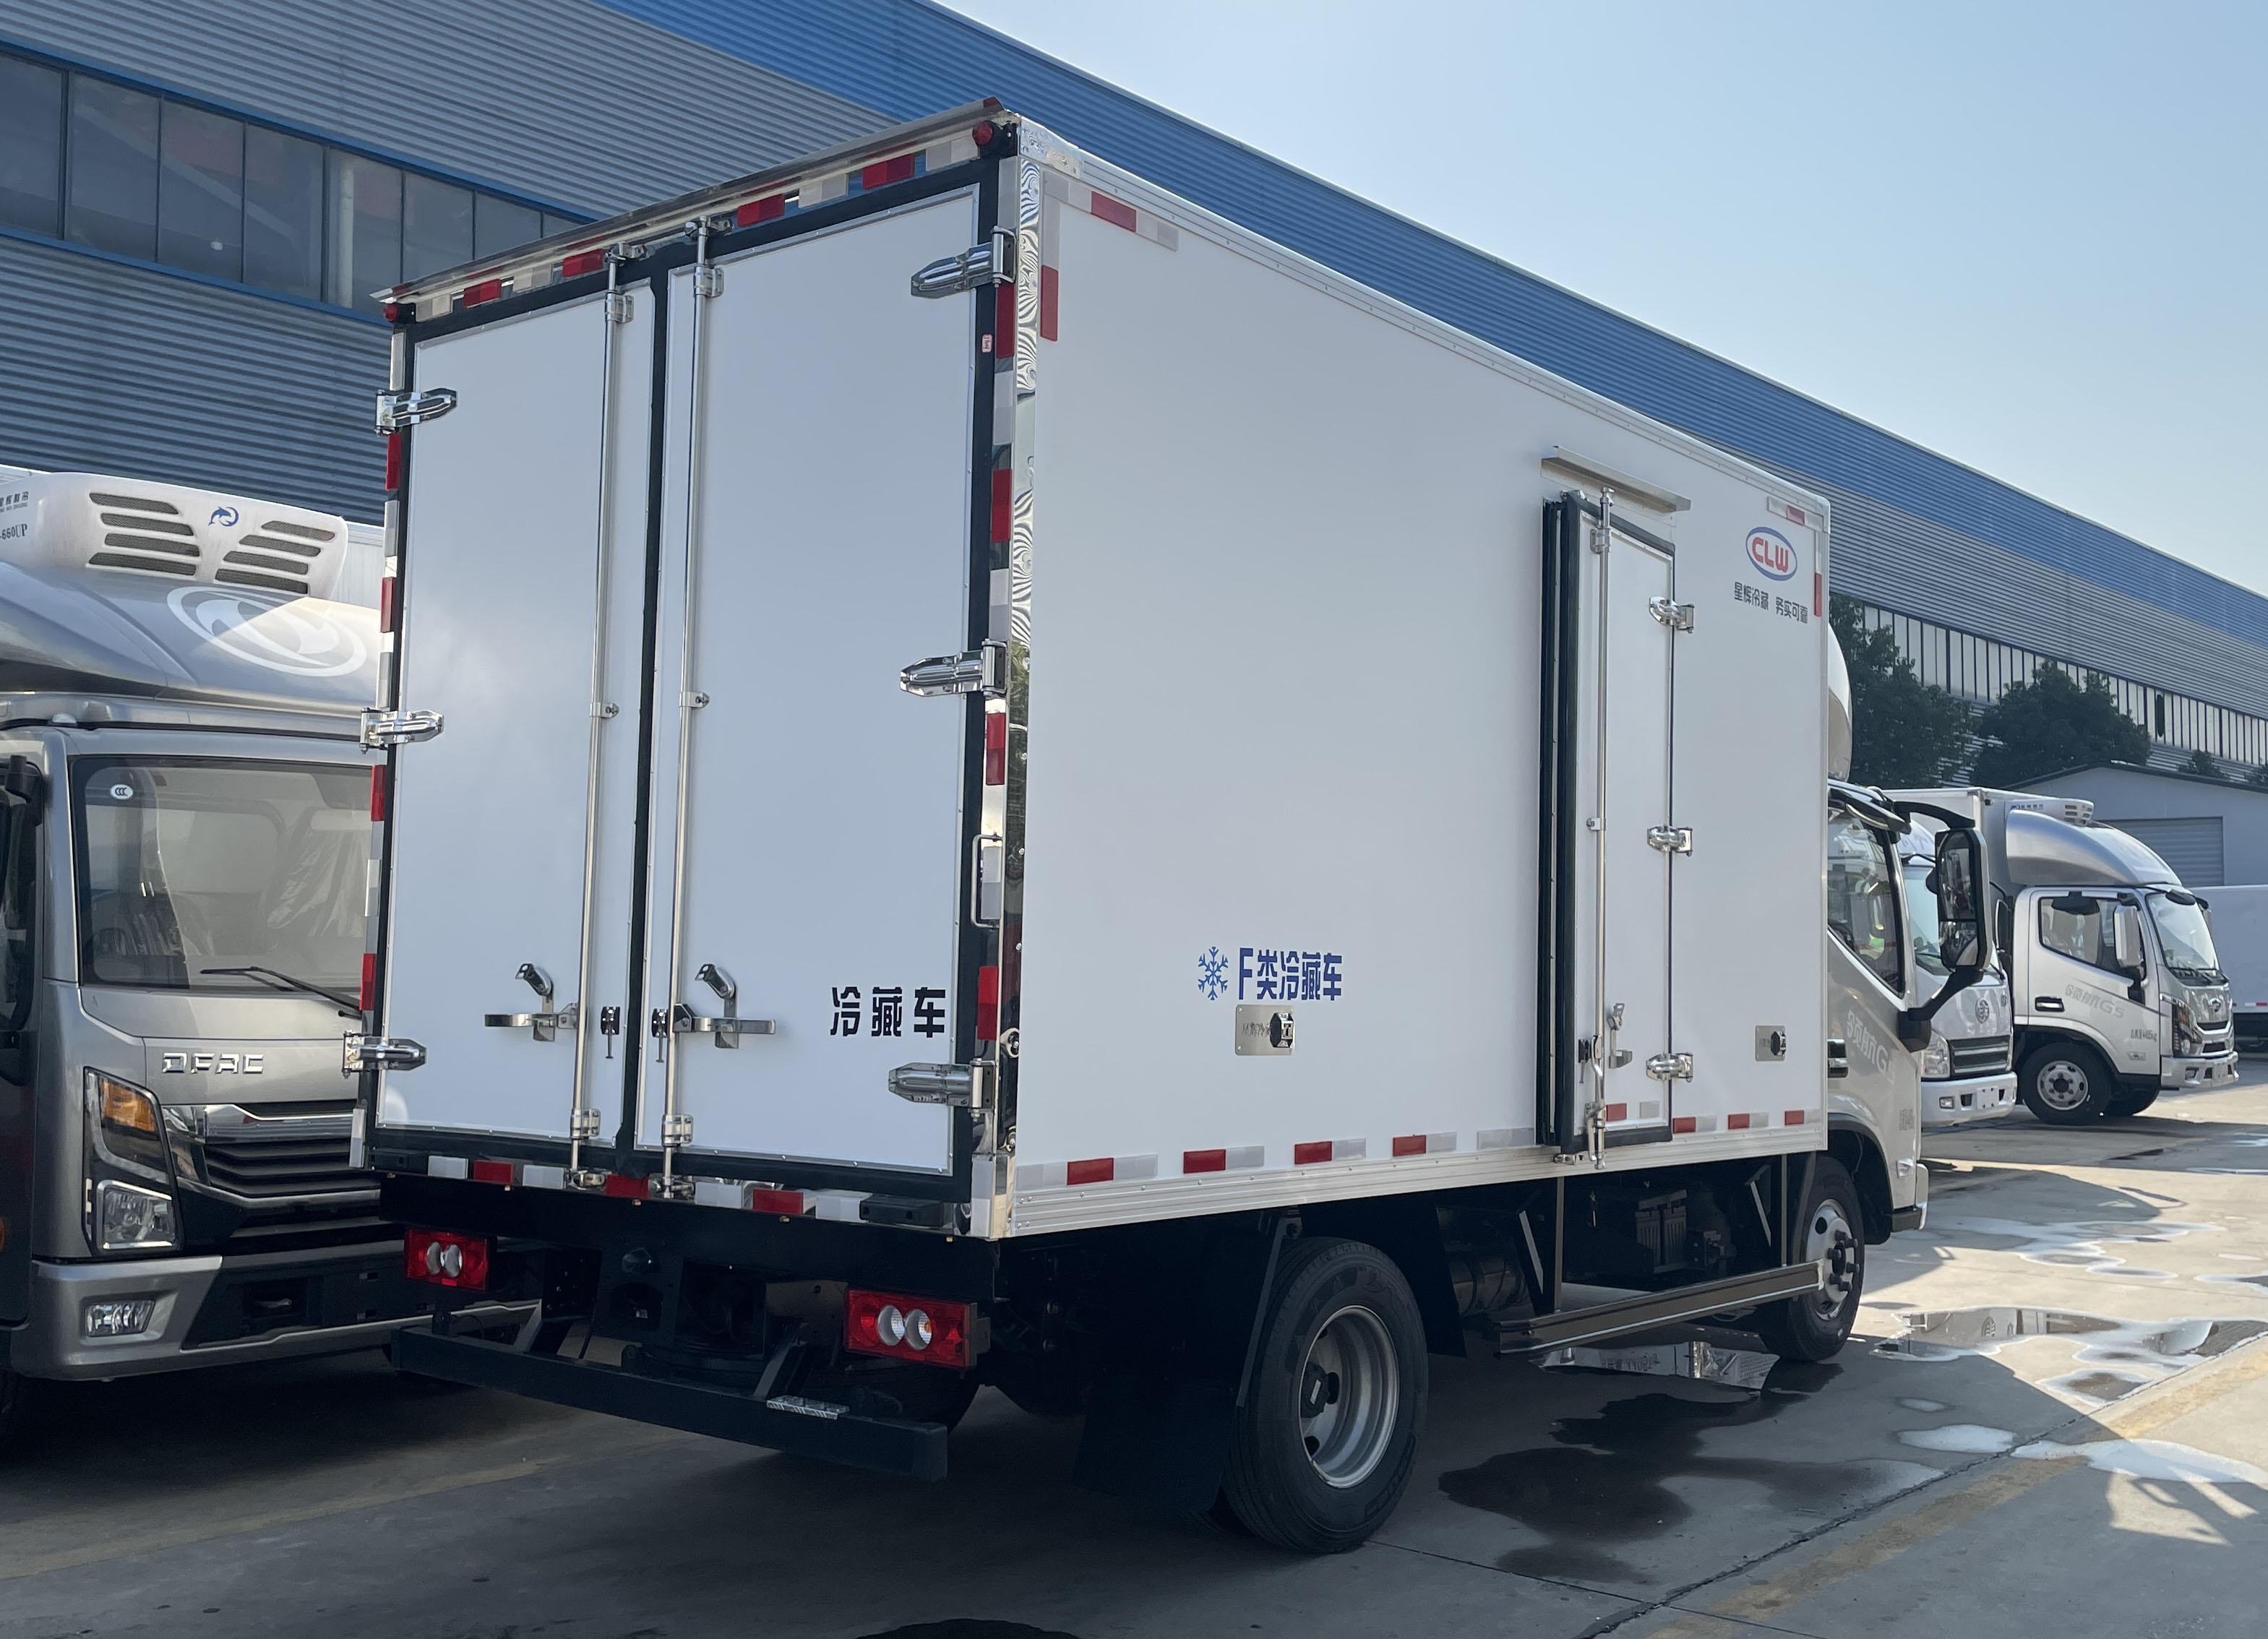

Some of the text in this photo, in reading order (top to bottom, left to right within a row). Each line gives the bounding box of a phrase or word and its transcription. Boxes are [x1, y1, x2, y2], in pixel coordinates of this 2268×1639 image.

[1752, 537, 1789, 573] CLW
[1734, 581, 1808, 624] 星辉冷藏 务实可靠
[1238, 947, 1342, 1001] F类冷藏车
[830, 986, 946, 1038] 冷藏车
[162, 1052, 265, 1075] DFAC
